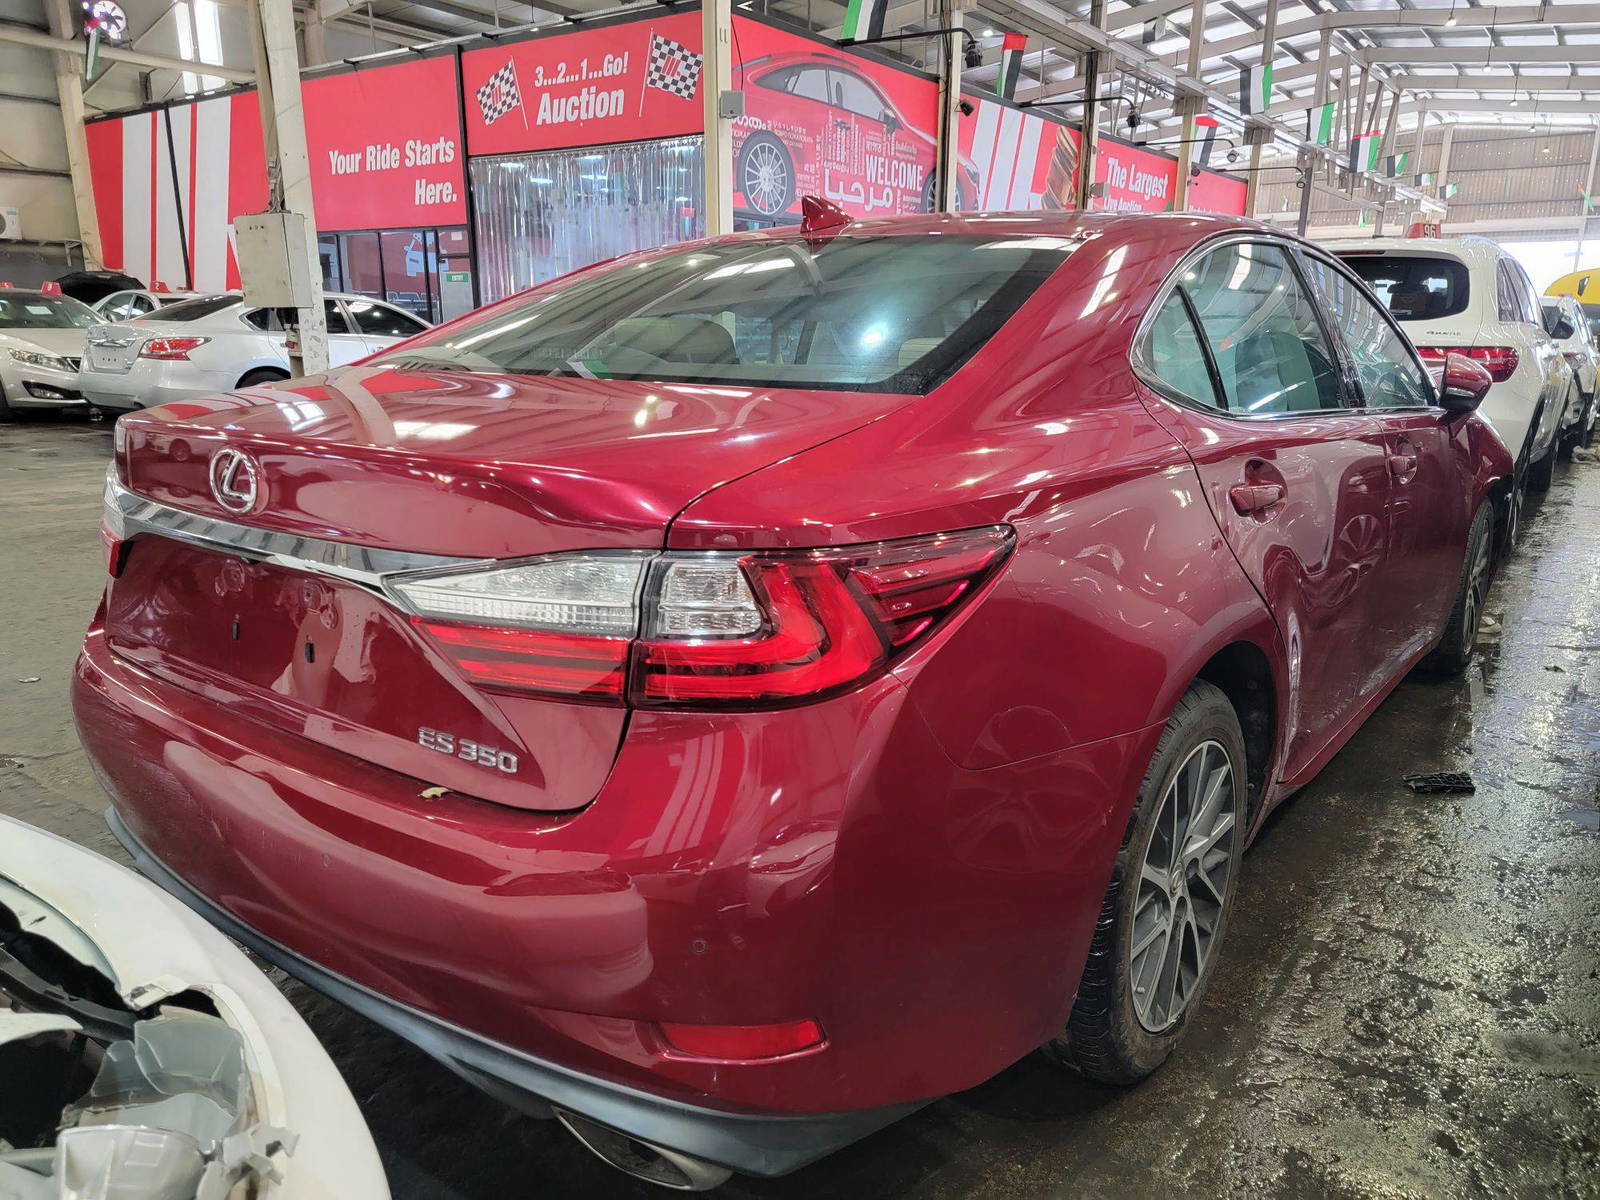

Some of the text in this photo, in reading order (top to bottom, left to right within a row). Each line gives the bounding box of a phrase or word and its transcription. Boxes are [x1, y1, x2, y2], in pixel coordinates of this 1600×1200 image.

[536, 86, 625, 126] Auction
[329, 136, 455, 175] Your Ride Starts
[865, 154, 923, 191] WELCOME
[415, 178, 458, 205] Here.
[825, 167, 893, 211] مرحبا
[1107, 157, 1168, 200] The Largest
[417, 726, 518, 773] ES 350
